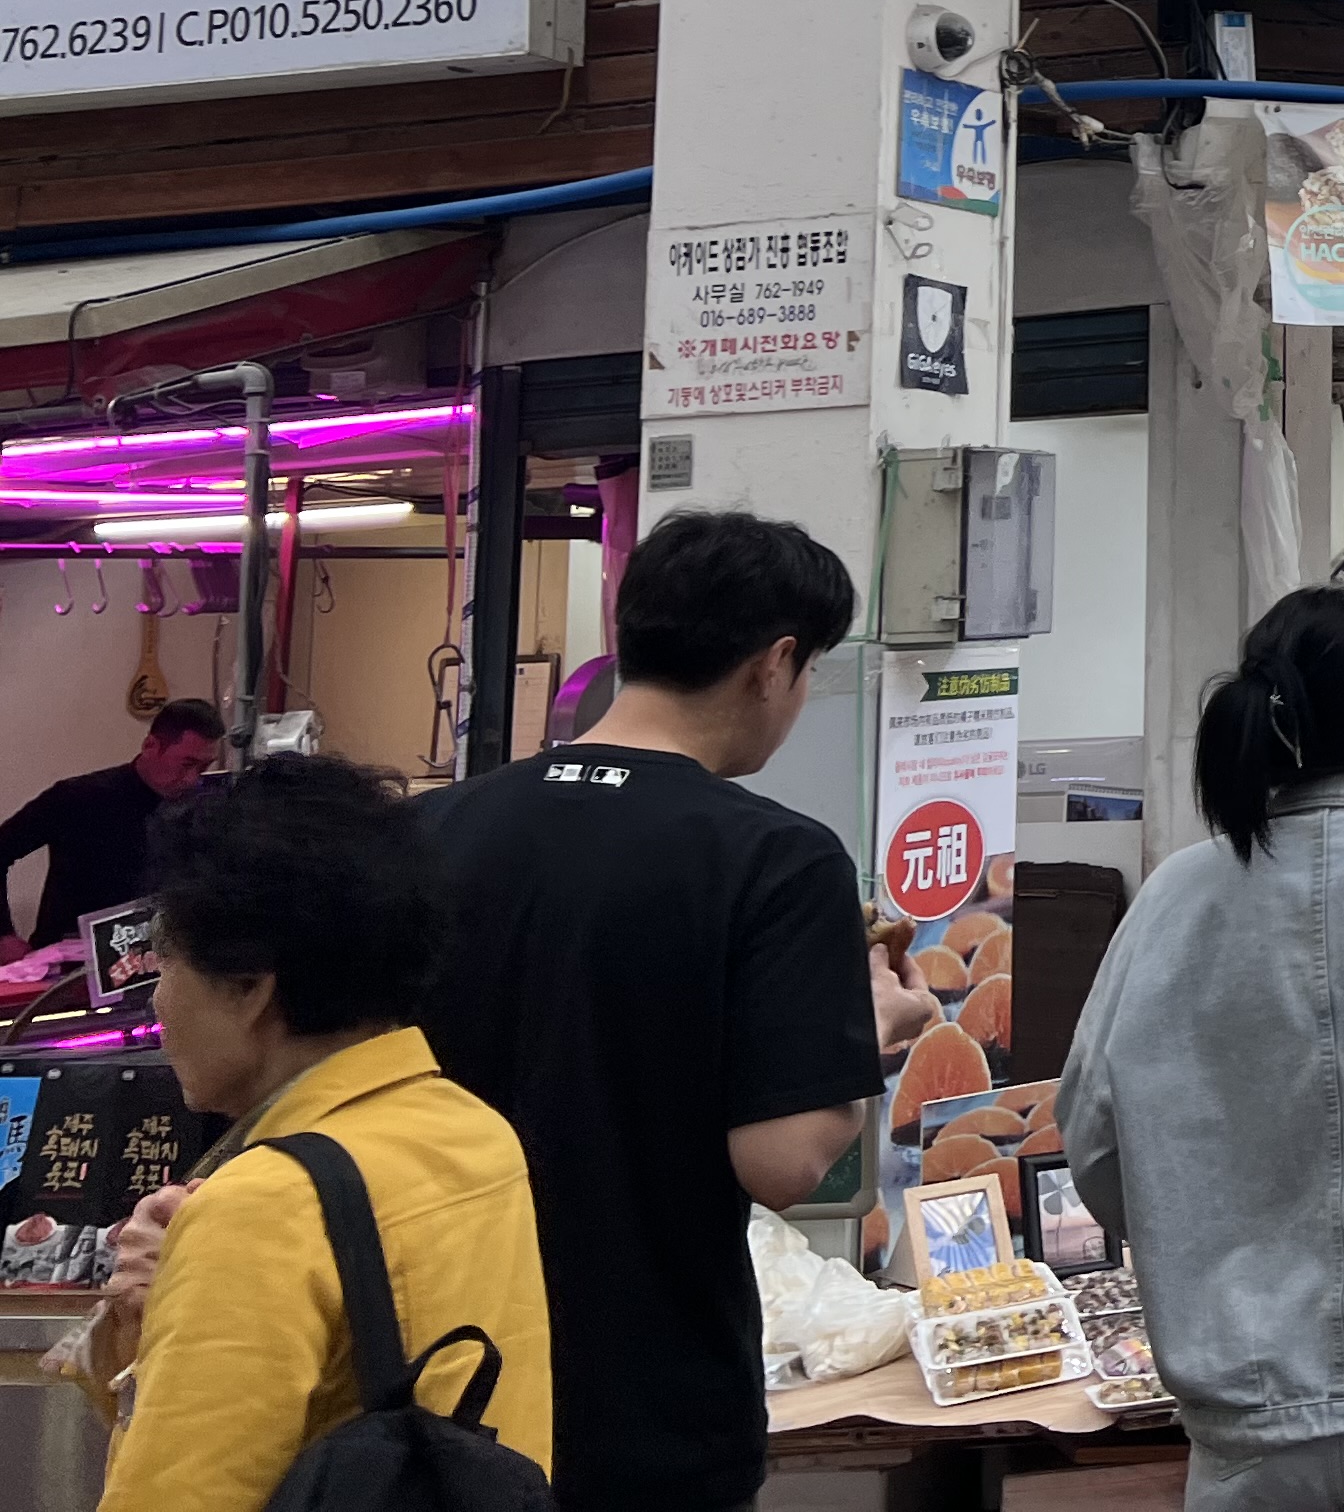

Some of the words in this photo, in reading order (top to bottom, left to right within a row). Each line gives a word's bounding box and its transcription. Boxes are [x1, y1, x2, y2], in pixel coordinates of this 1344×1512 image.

[669, 240, 719, 276] 아케이드
[722, 237, 760, 273] 상점가
[766, 234, 791, 269] 진흥
[797, 229, 848, 267] 협동조합
[692, 283, 745, 304] 사무실
[755, 279, 824, 299] 762-1949
[700, 304, 816, 328] 016-689-3888
[668, 387, 705, 408] 기둥에
[791, 374, 843, 397] 부착금지
[1029, 763, 1046, 775] LG
[901, 823, 967, 894] 元祖
[63, 1113, 95, 1135] 제주
[142, 1115, 173, 1137] 제주
[40, 1125, 99, 1161] 흑돼지
[122, 1128, 179, 1164] 흑돼지
